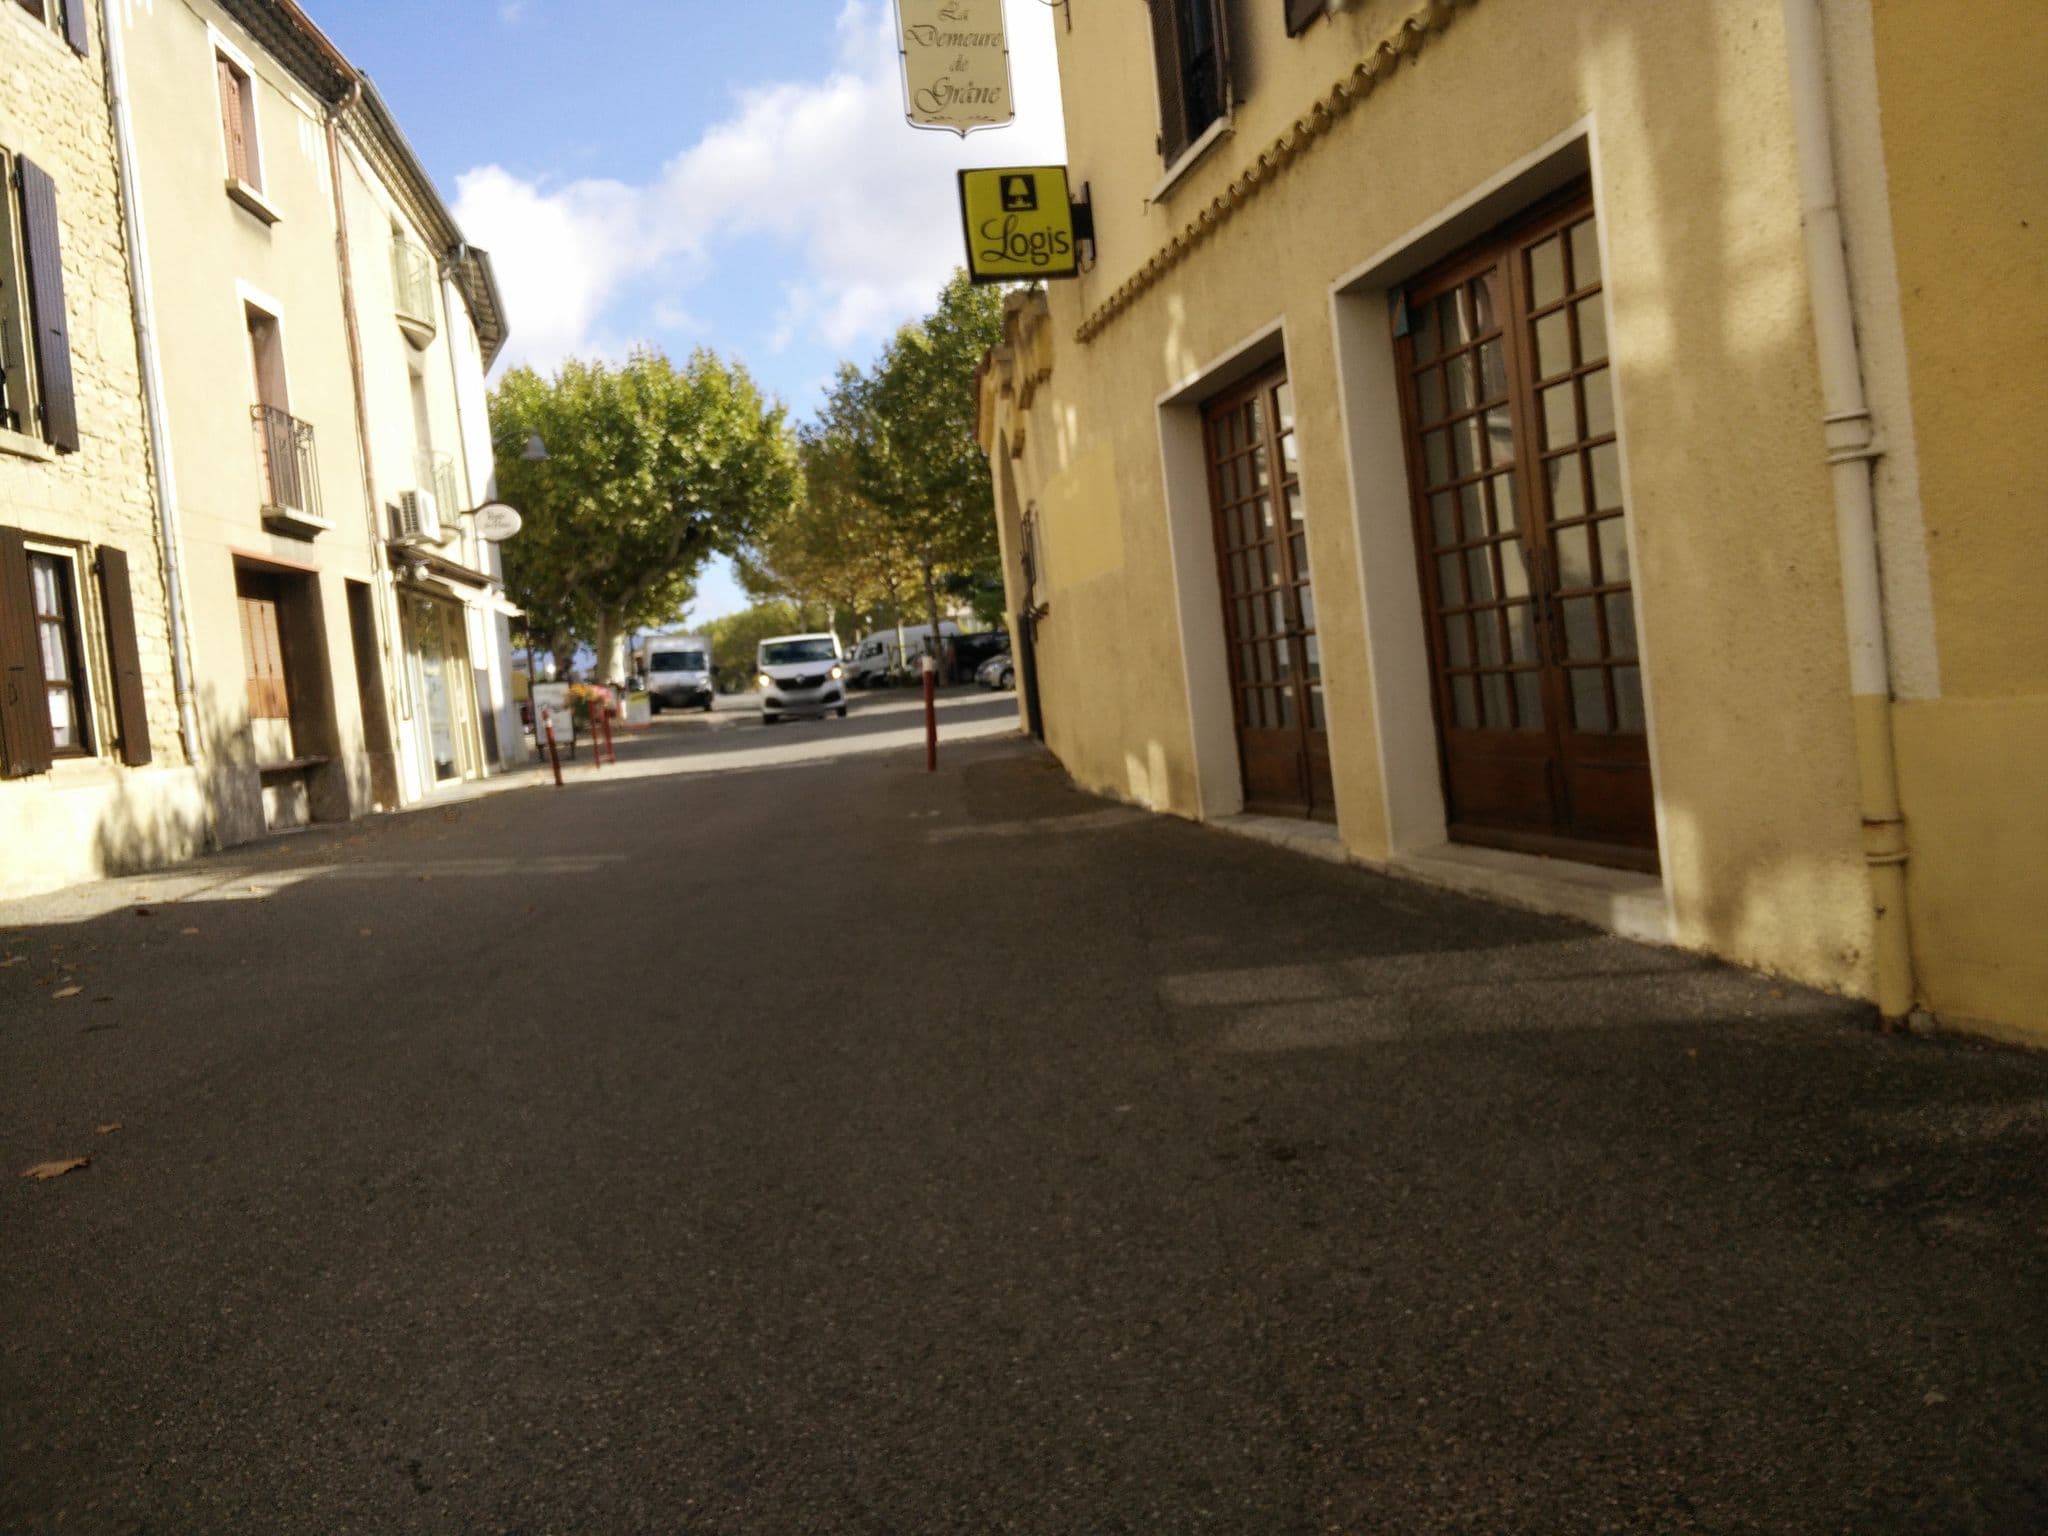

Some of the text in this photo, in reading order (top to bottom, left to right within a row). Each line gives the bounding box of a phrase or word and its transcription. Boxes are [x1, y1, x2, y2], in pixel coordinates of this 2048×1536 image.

[905, 24, 1003, 47] Demeure
[949, 54, 969, 72] de
[914, 77, 1002, 114] Grâne
[980, 214, 1070, 266] Logis
